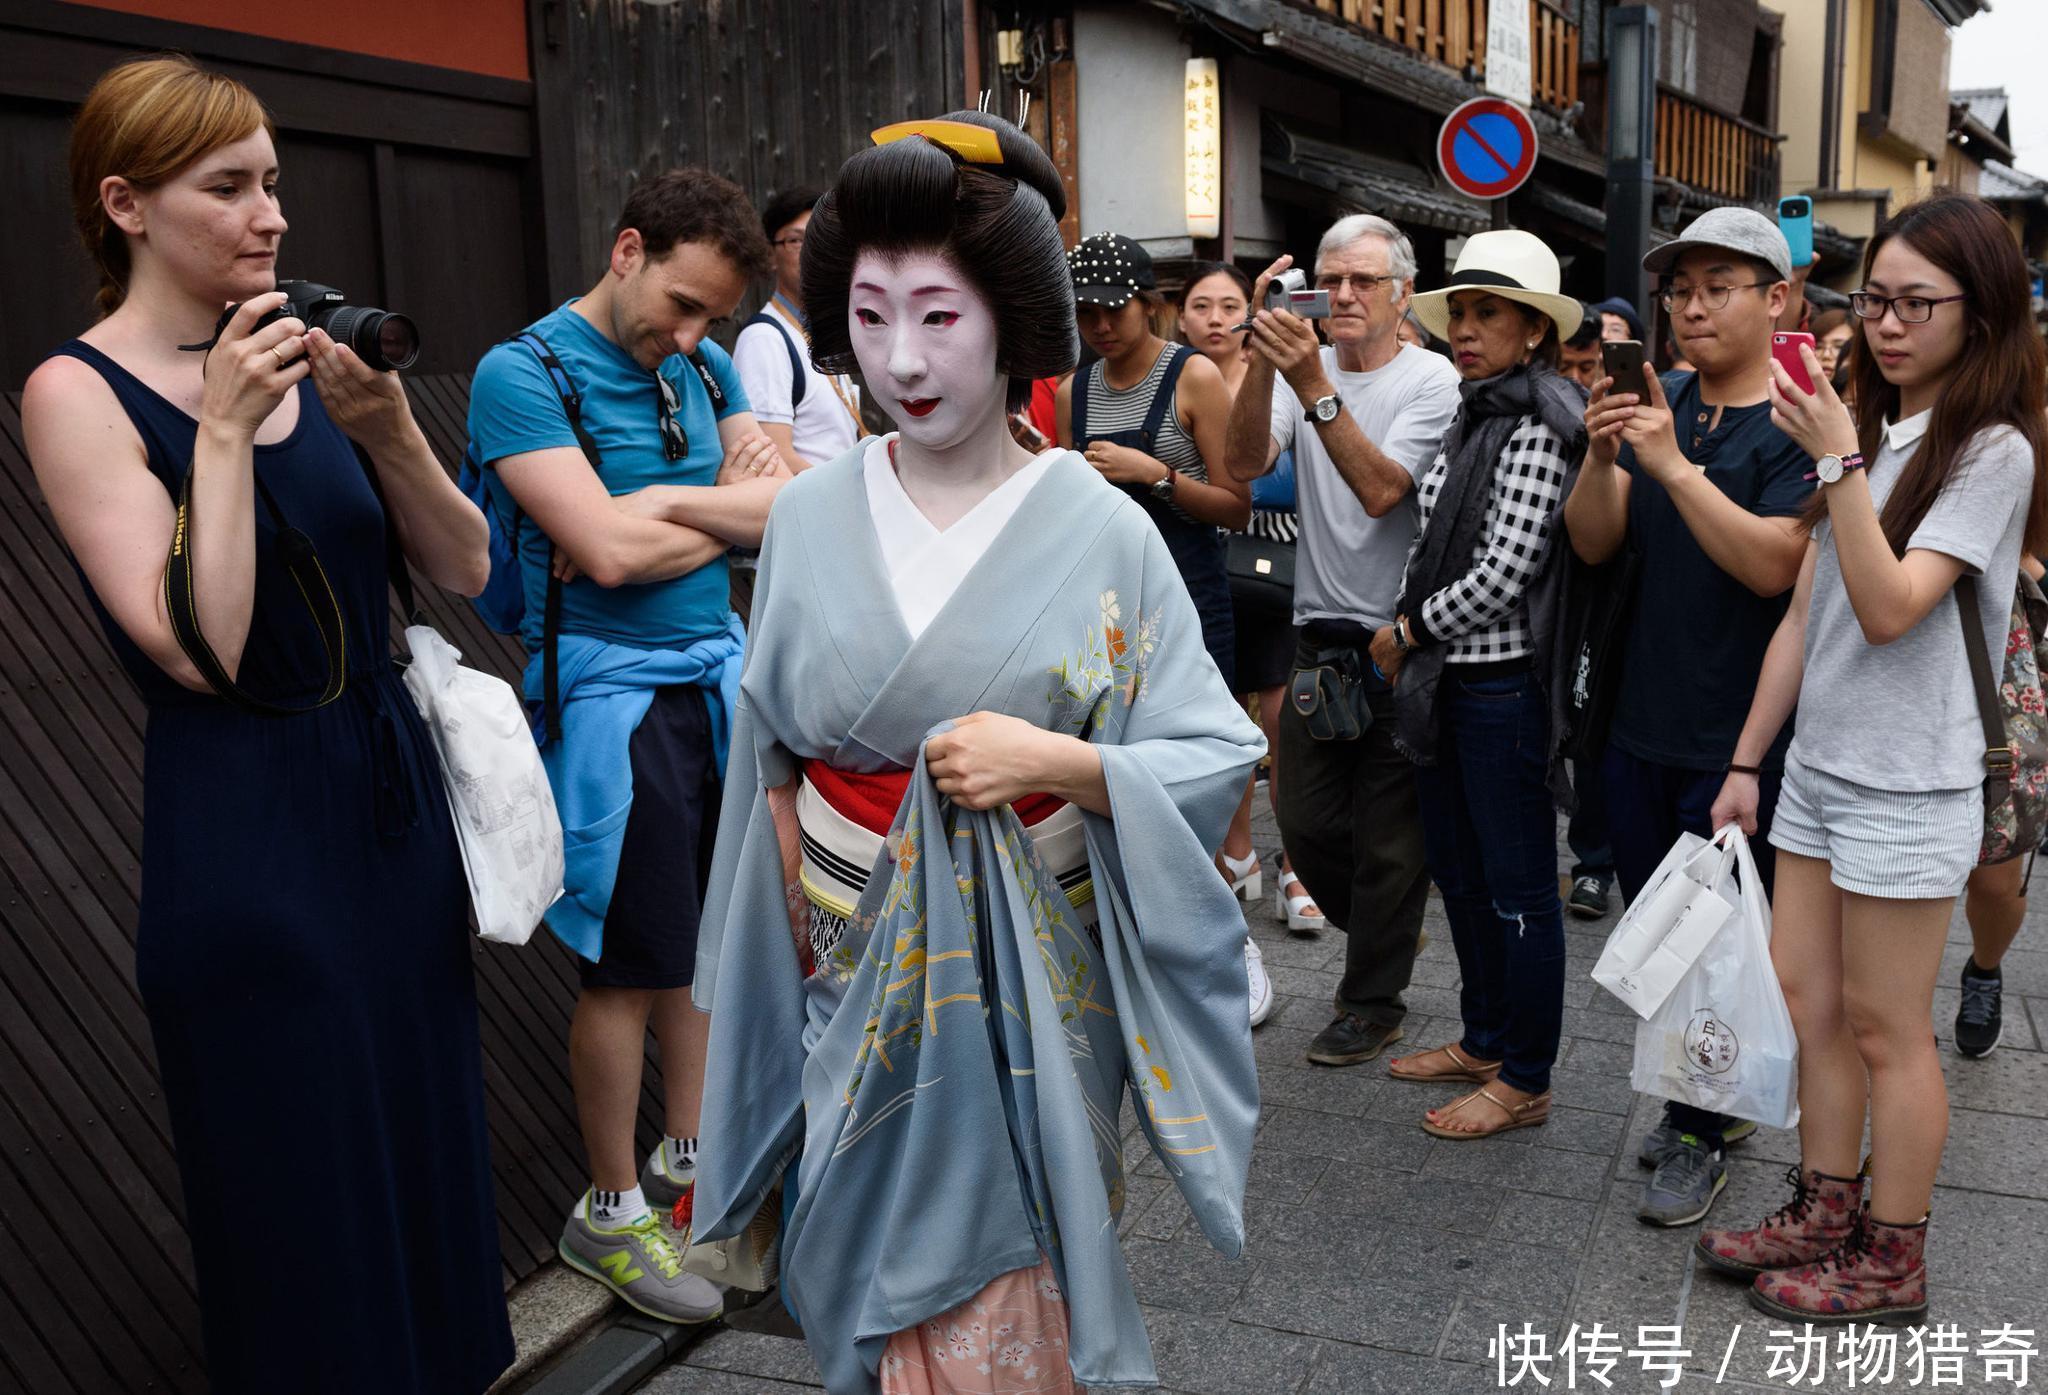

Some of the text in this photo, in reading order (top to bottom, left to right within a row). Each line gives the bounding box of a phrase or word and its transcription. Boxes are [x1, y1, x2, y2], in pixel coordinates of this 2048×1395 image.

[326, 293, 344, 301] Nikon
[174, 504, 186, 556] Nikon
[598, 1250, 645, 1287] N
